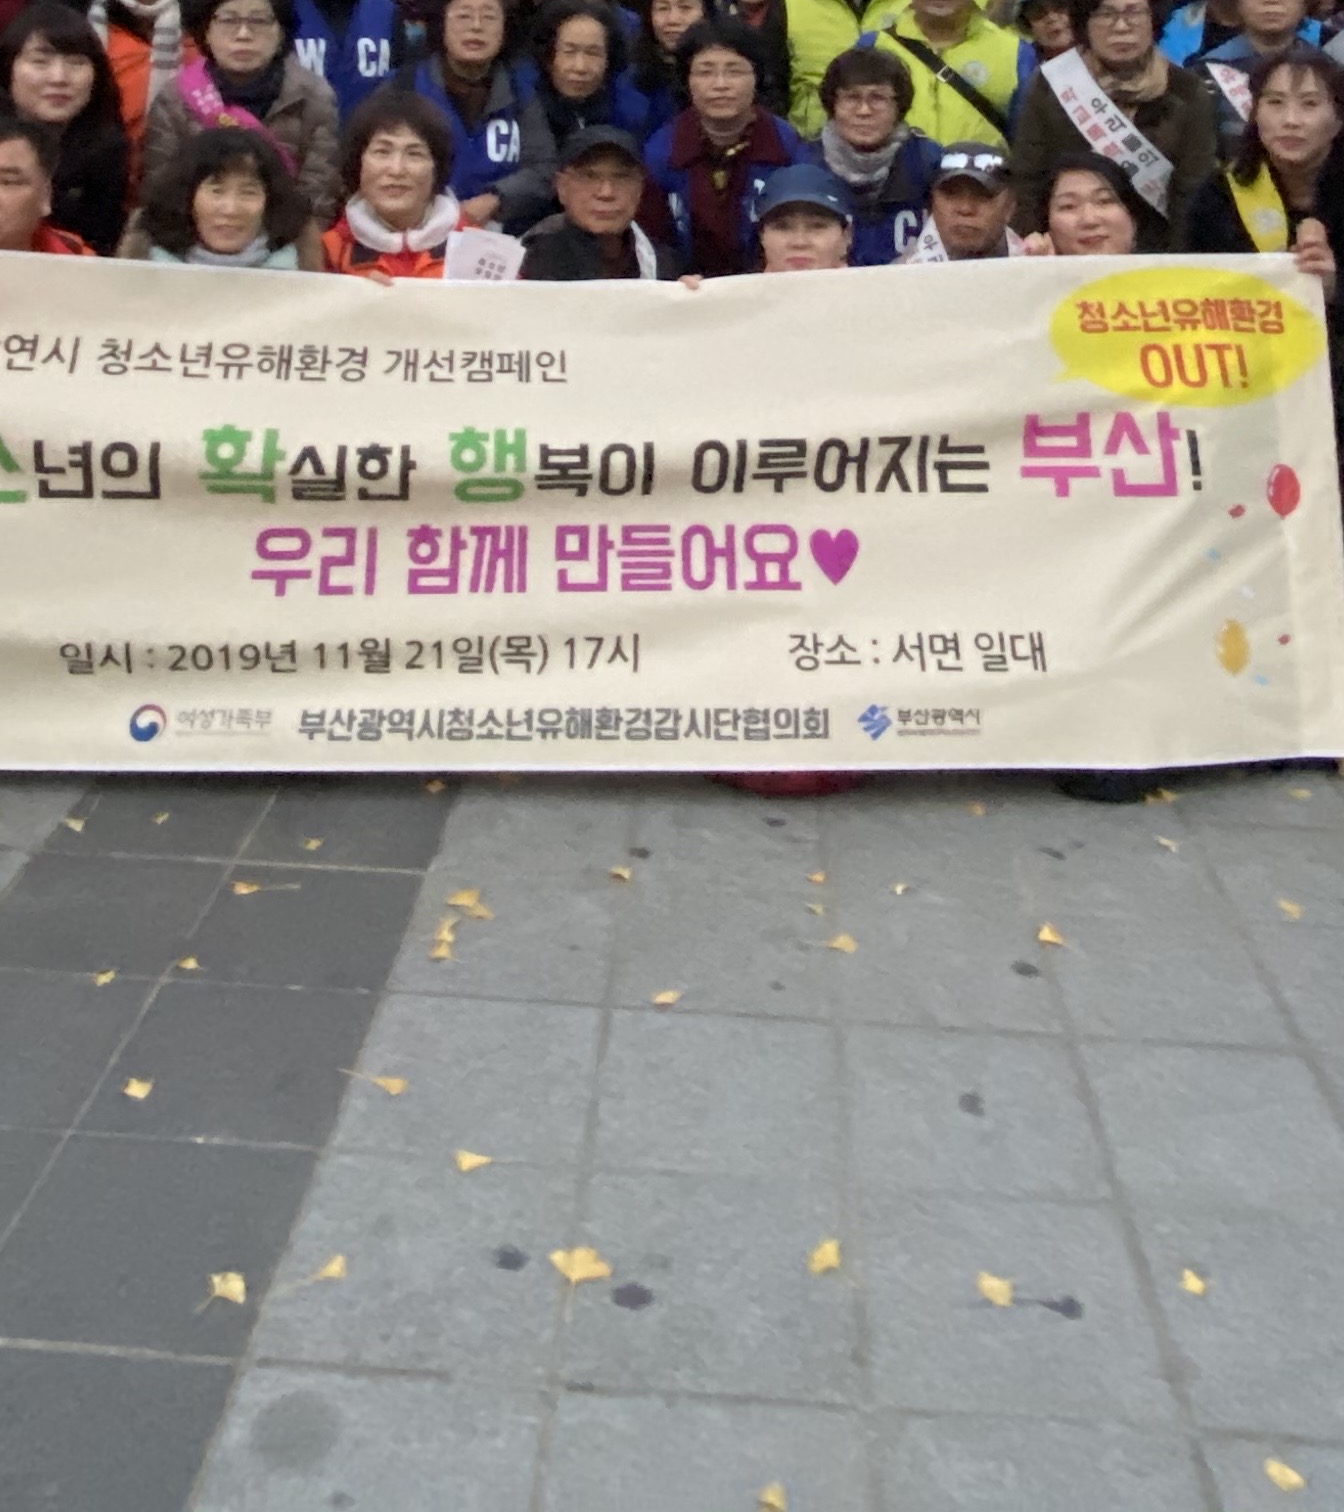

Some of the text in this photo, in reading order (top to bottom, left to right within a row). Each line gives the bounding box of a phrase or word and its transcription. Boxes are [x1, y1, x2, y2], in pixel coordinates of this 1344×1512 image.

[1076, 298, 1286, 334] 청소년유해환경
[97, 338, 369, 382] 청소년유해환경
[383, 348, 568, 384] 개선캠페인
[1140, 342, 1250, 390] OUT!
[198, 424, 417, 504] 확실한
[448, 426, 655, 503] 행복이
[691, 434, 990, 494] 이루어지는
[1020, 411, 1202, 498] 부산!
[251, 524, 802, 597] 우리 함께 만들어요
[59, 641, 132, 675] 일시
[167, 639, 298, 674] 2019년
[313, 637, 393, 675] 11월
[404, 634, 550, 675] 21일(목)
[563, 633, 641, 673] 17시
[788, 631, 862, 671] 장소
[892, 631, 963, 673] 서면
[974, 631, 1048, 673] 일대
[176, 706, 982, 742] 여성가족부 부산광역시청소년유해환경감시단협의회 부산광역시
